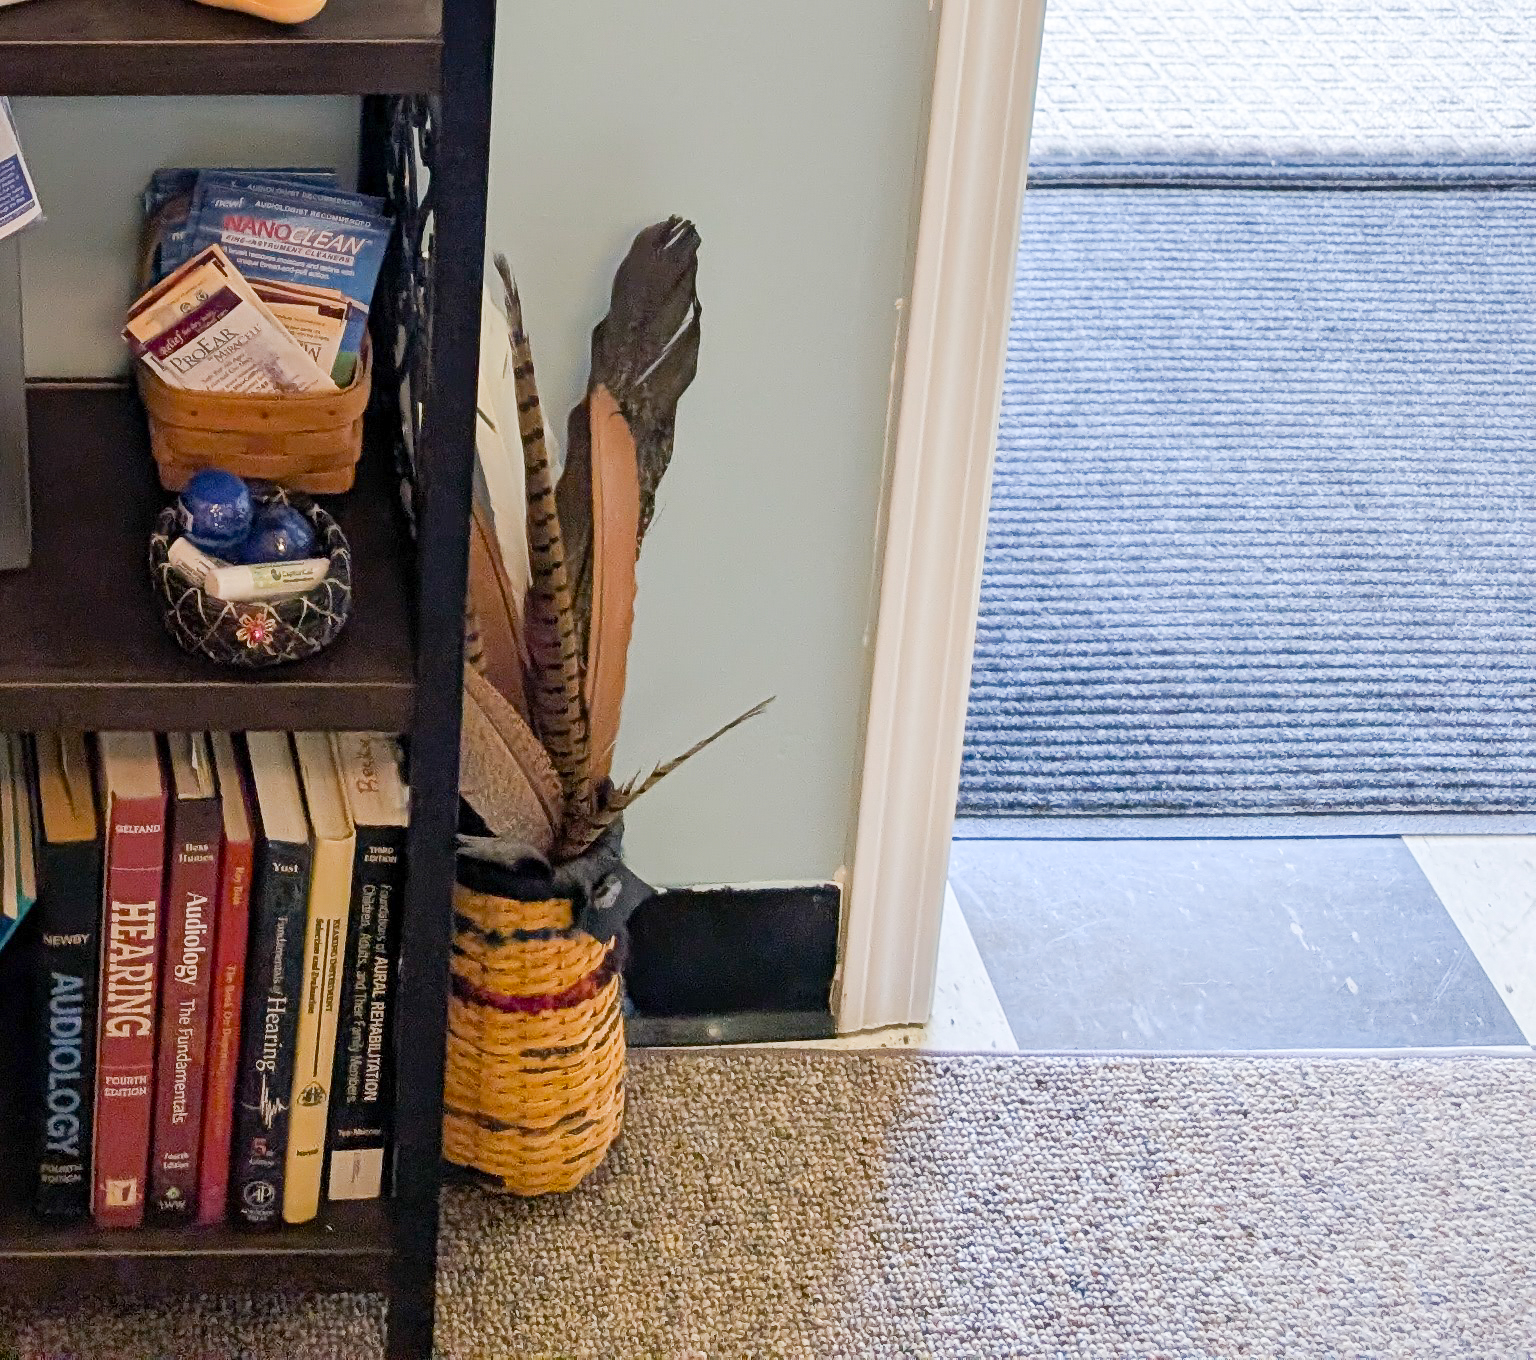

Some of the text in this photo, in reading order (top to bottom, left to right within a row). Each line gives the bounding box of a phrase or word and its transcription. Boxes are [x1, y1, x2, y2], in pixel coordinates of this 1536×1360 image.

[223, 214, 366, 256] NANOCLEAN
[115, 823, 161, 834] GELFAND
[43, 933, 90, 947] NEWBY
[104, 900, 156, 1038] HEARING
[371, 956, 390, 997] AURAL
[171, 891, 208, 1124] Audiology The Fundamentals
[255, 996, 289, 1072] Hearing
[363, 1001, 386, 1102] REHABILITATION
[46, 971, 84, 1158] AUDIOLOGY
[105, 1075, 147, 1085] FOURTH
[104, 1086, 147, 1097] EDITION
